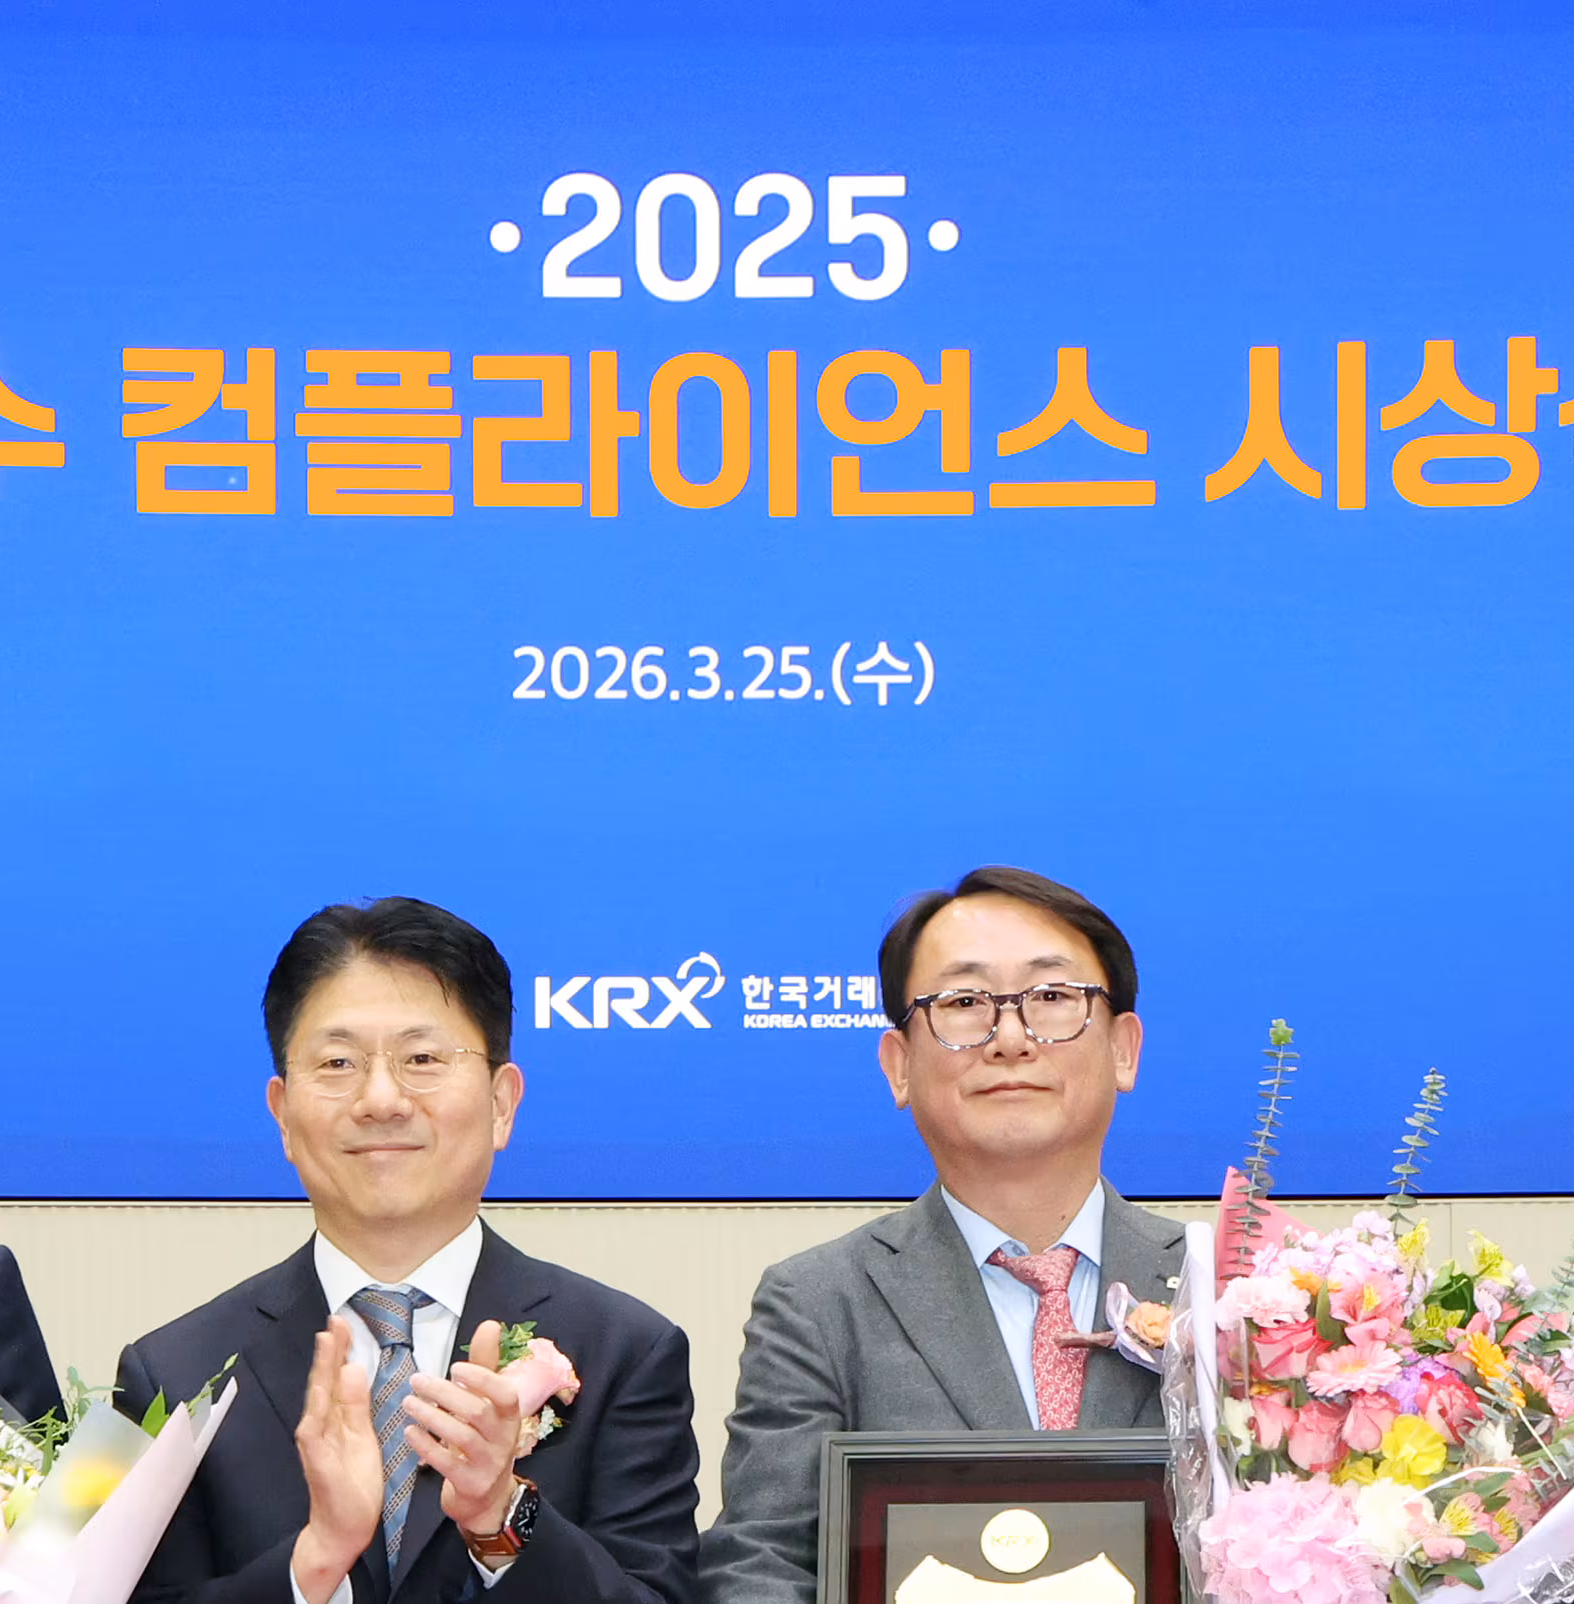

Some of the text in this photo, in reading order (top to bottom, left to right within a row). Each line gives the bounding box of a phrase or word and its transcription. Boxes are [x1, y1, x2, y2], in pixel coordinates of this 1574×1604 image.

[122, 346, 1156, 517] 컴플라이언스
[512, 641, 935, 706] 2026.3.25.(수)
[534, 952, 725, 1029] KRX
[741, 974, 882, 1010] 한국거래
[743, 1014, 807, 1029] KOREA
